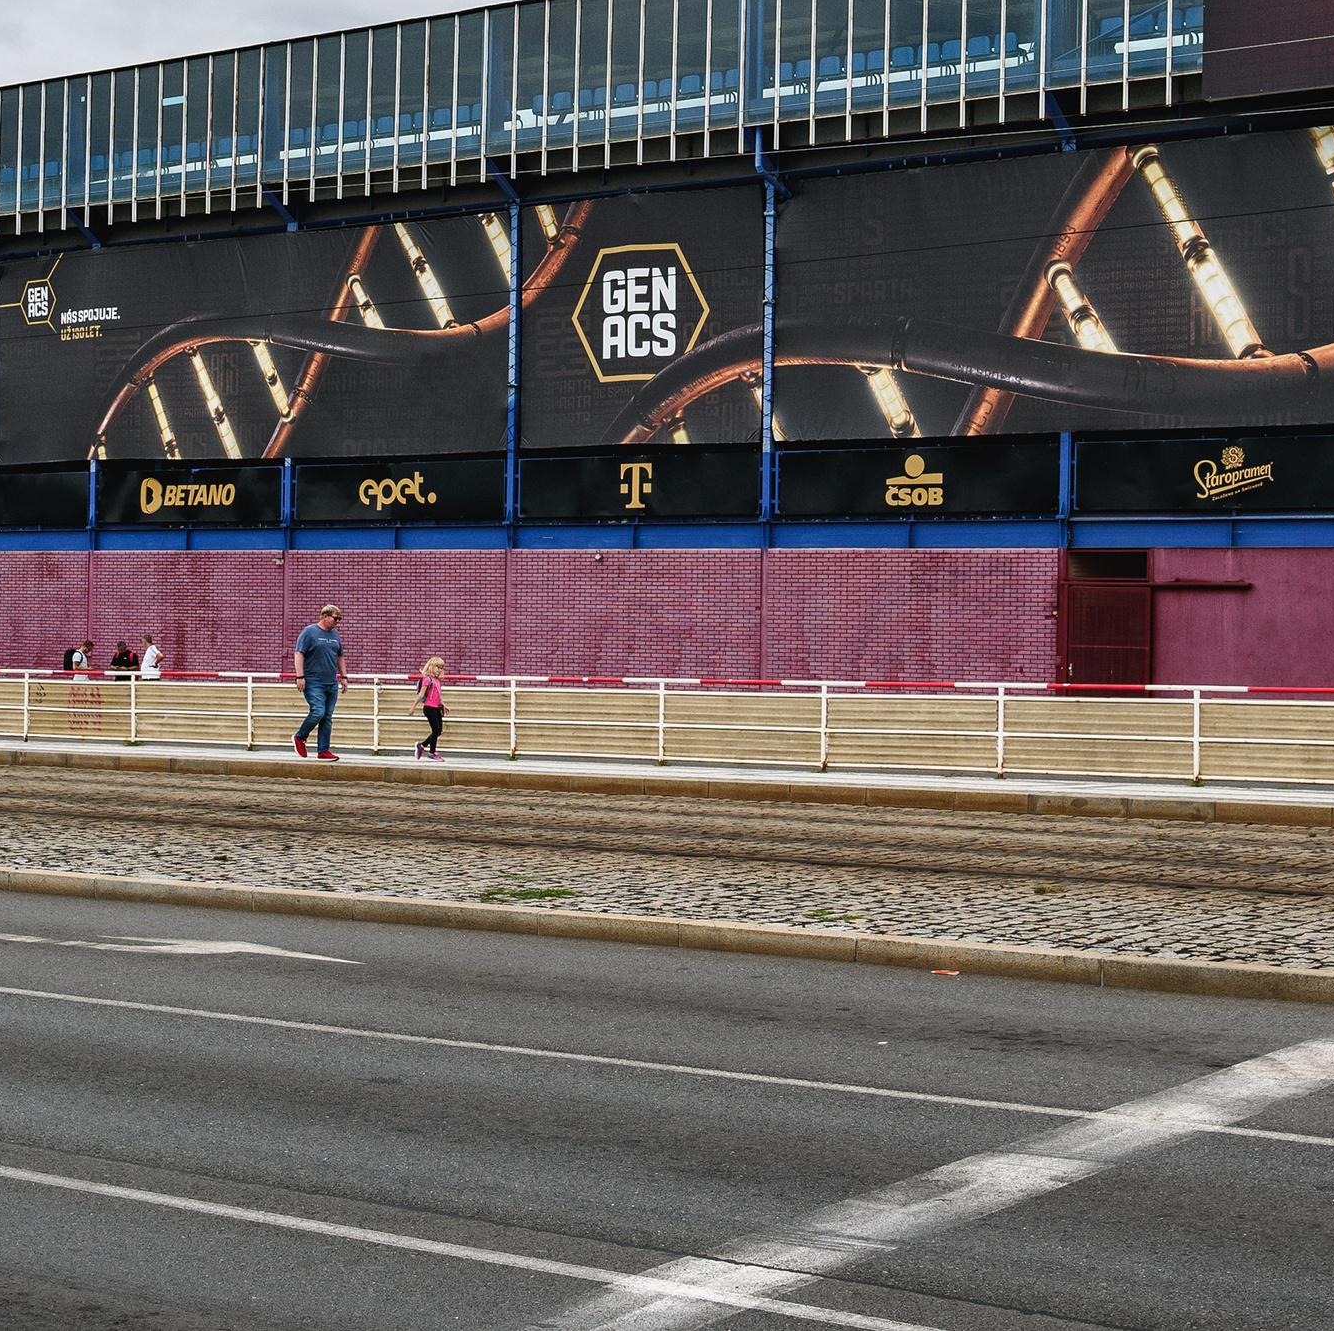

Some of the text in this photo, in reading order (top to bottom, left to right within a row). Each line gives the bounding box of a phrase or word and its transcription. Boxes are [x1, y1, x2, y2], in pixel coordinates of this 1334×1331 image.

[27, 285, 49, 303] GEN
[602, 267, 677, 315] GEN
[27, 301, 49, 318] ACS
[61, 306, 121, 325] NÁS SPOJUJE.
[602, 312, 677, 361] ACS
[358, 471, 437, 511] epet.
[1193, 459, 1274, 499] Staropramen
[163, 482, 236, 507] BETANO
[885, 483, 944, 506] ČSOB
